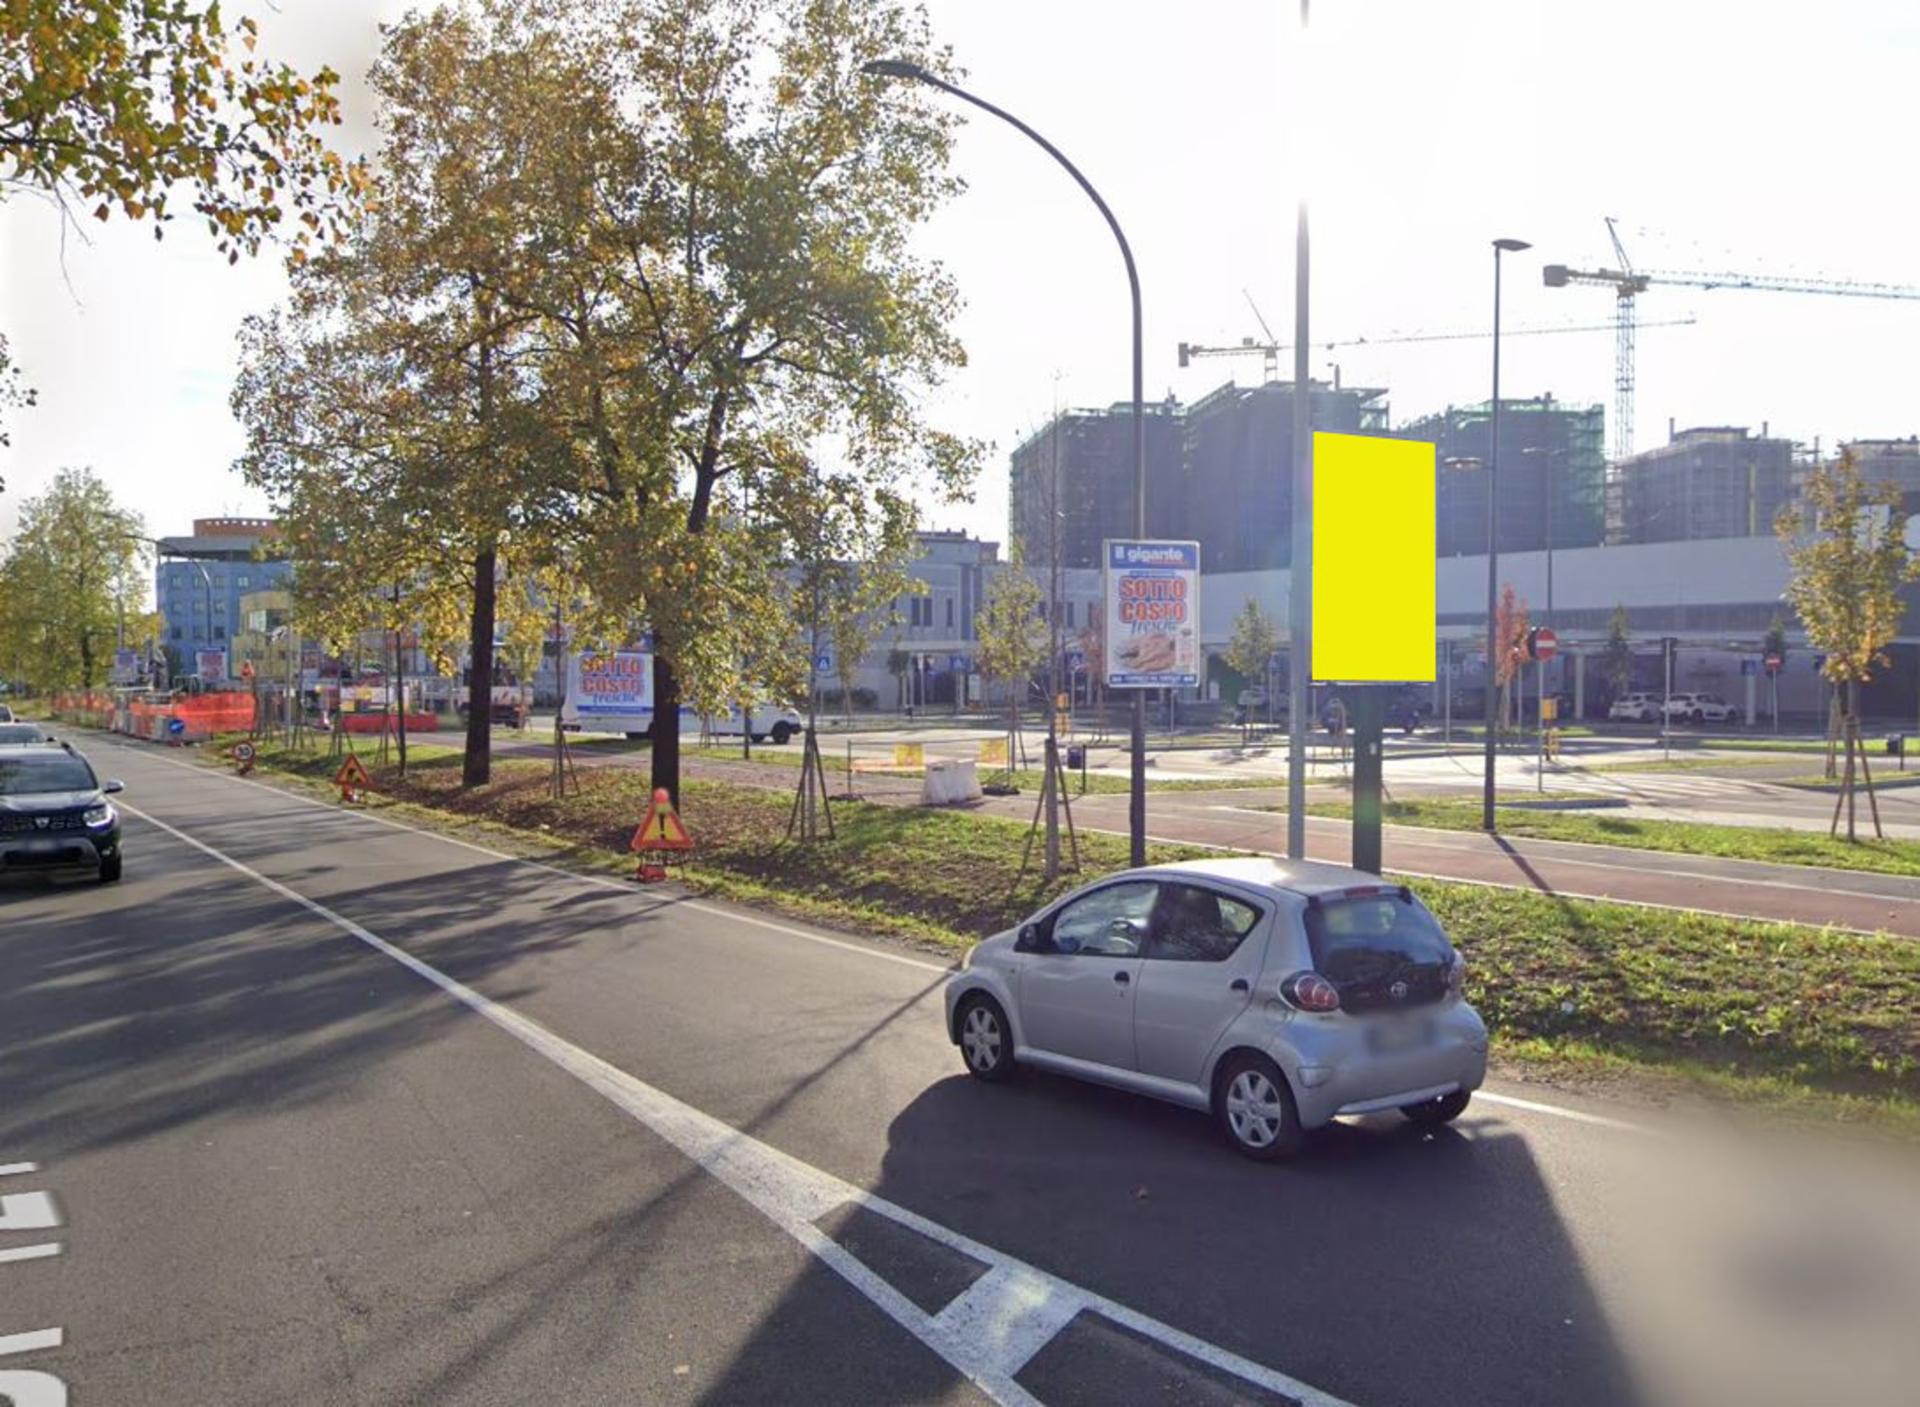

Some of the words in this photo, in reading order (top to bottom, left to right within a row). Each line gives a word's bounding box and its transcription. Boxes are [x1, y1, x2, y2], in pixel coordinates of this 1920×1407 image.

[1127, 546, 1184, 562] gigante
[1121, 578, 1186, 598] SOTTO
[1121, 601, 1186, 622] COSTO
[582, 677, 641, 694] COSTO
